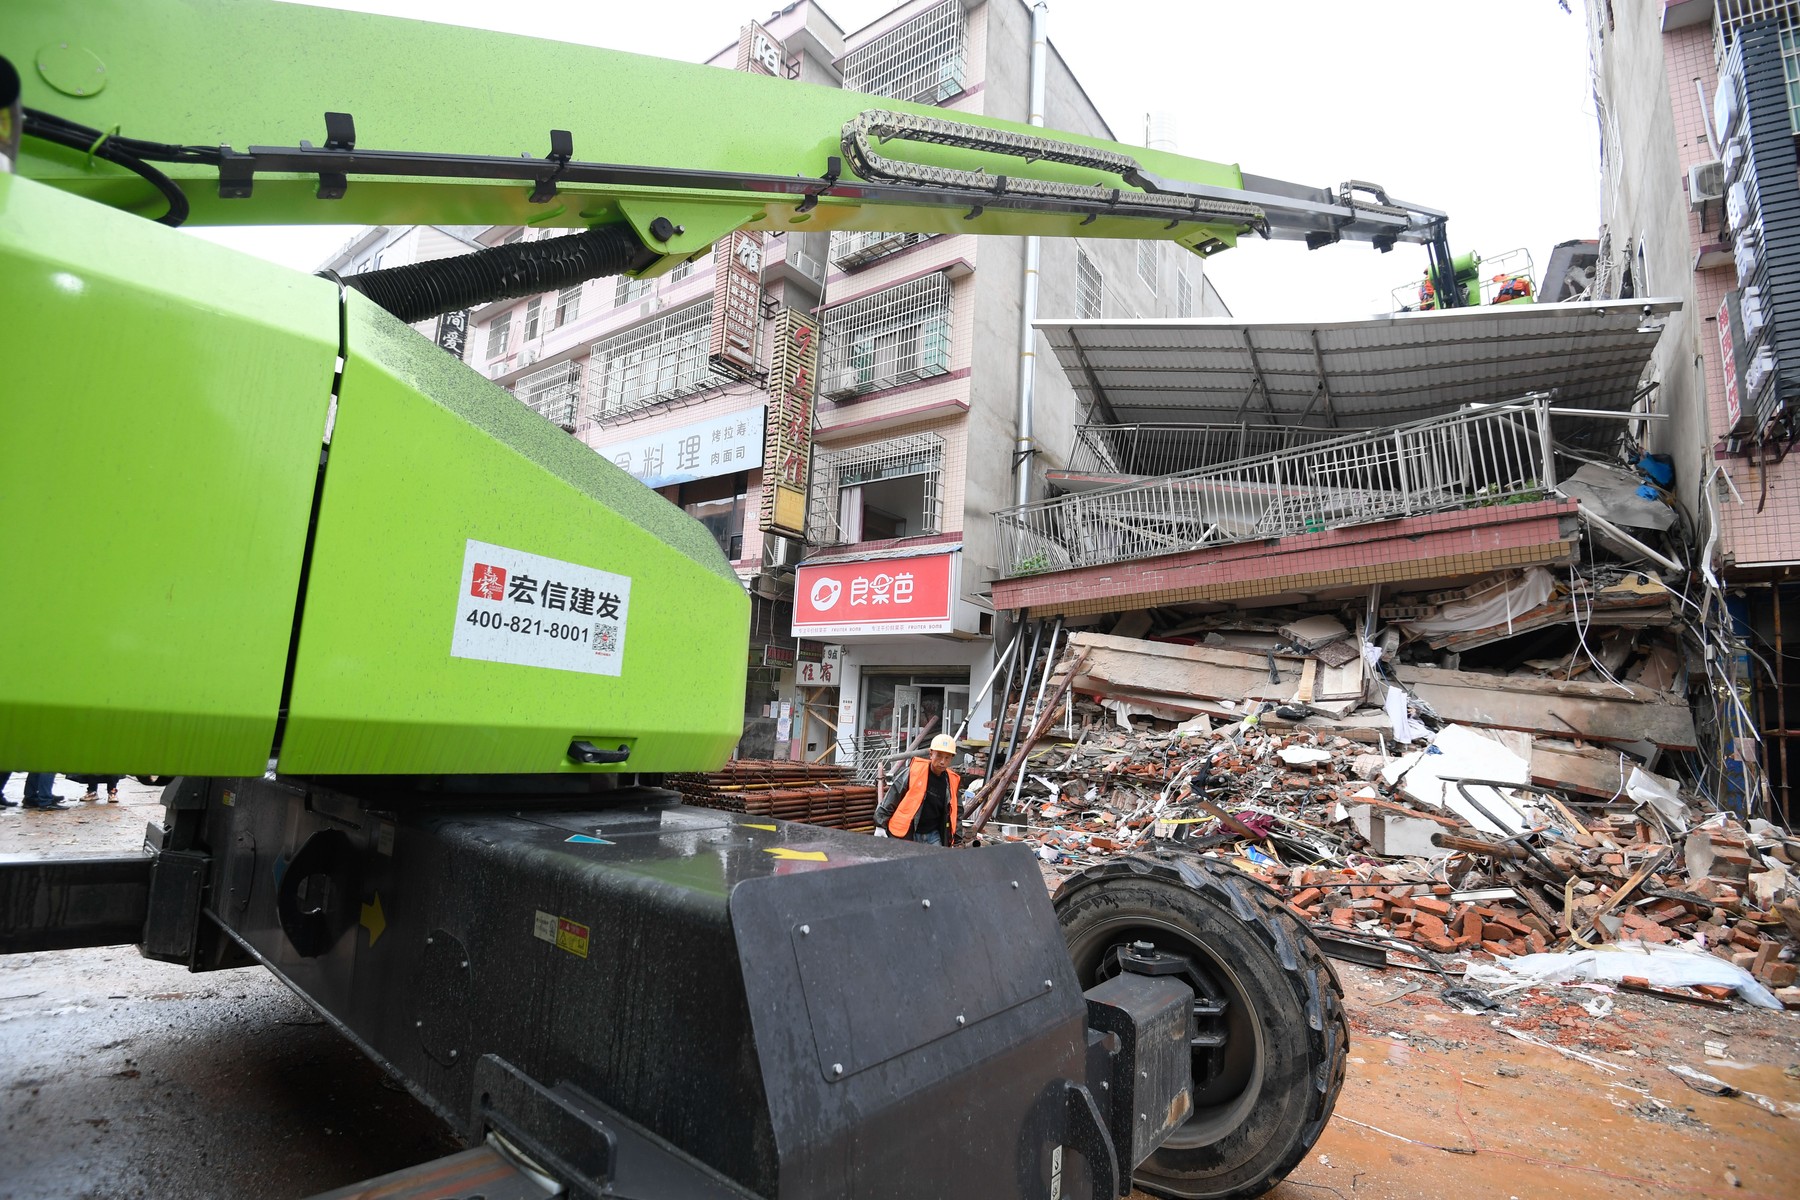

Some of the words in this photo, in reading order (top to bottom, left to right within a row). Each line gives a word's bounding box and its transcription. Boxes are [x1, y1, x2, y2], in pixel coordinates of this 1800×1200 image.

[508, 575, 621, 621] 宏信建发
[467, 609, 588, 643] 400-821-8001
[802, 662, 833, 682] 住宿
